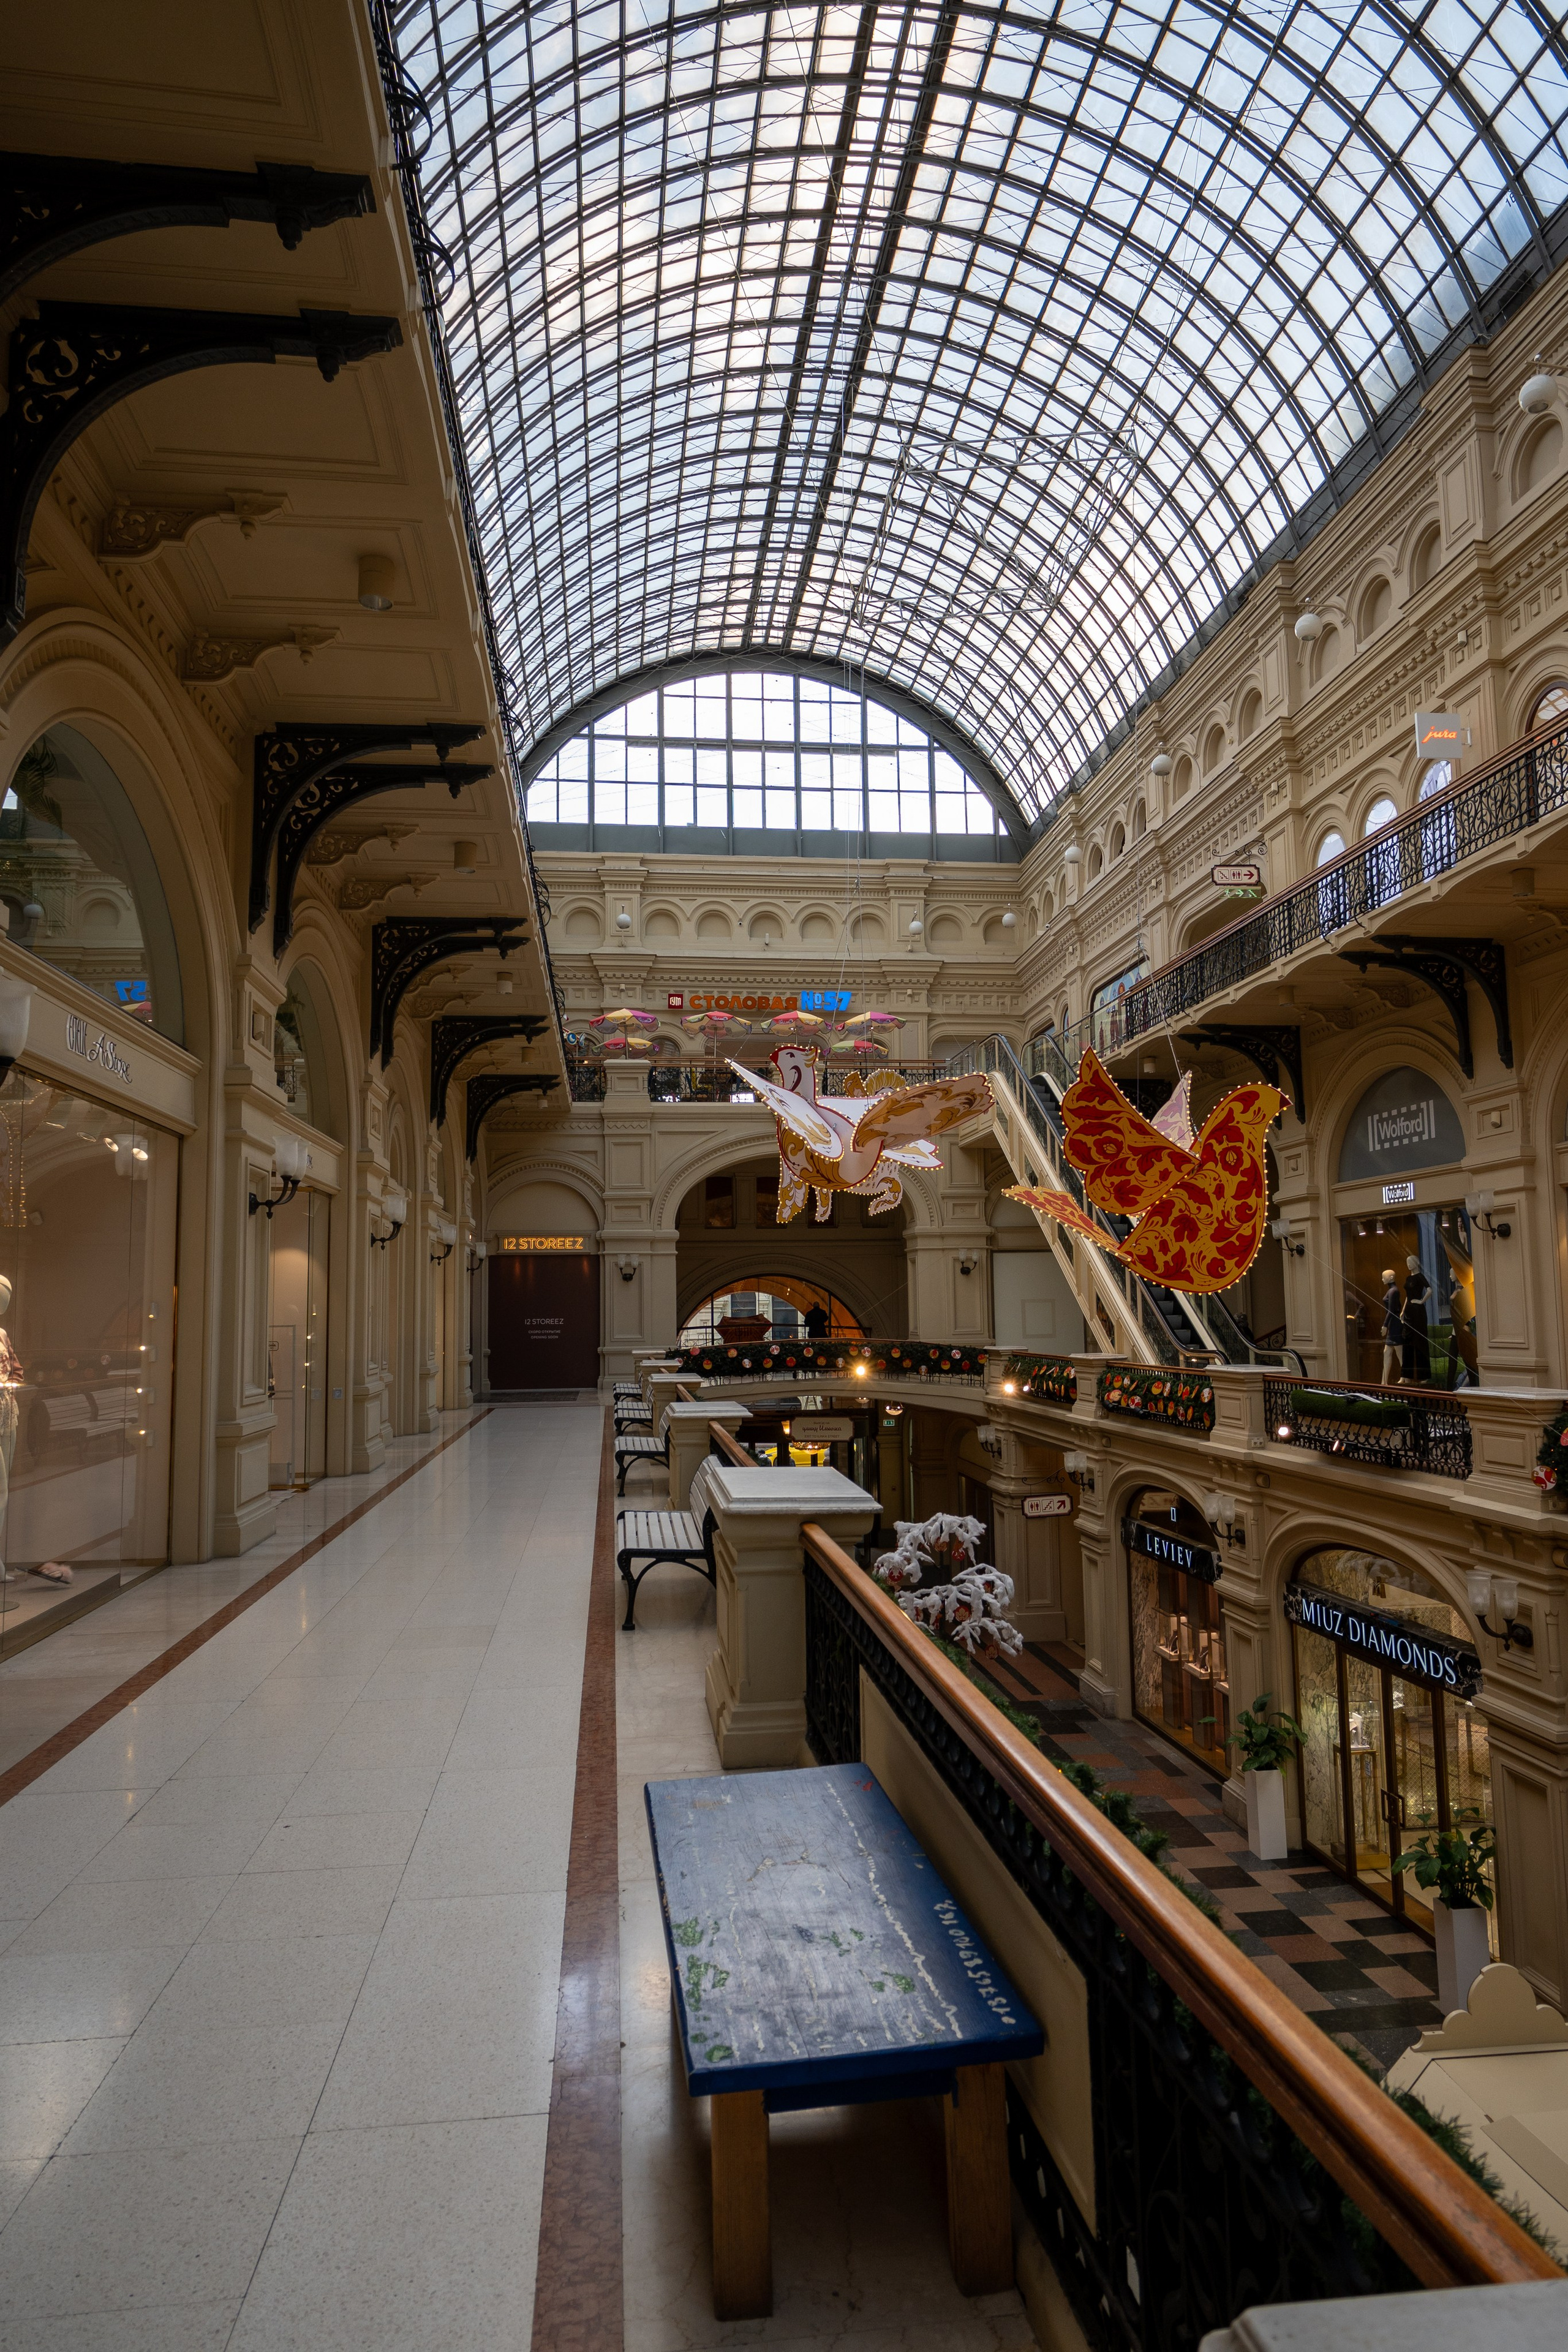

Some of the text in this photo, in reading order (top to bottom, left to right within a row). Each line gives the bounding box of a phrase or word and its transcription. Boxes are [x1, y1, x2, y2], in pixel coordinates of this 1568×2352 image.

[1422, 726, 1457, 744] jura
[689, 995, 797, 1010] СТОЛОВАЯ
[1378, 1112, 1423, 1140] Wolford
[1388, 1188, 1408, 1199] Wolford
[503, 1237, 584, 1250] 12 STOREEZ
[1146, 1533, 1192, 1568] LEVIEV
[1302, 1598, 1457, 1684] MIUZ DIAMONDS
